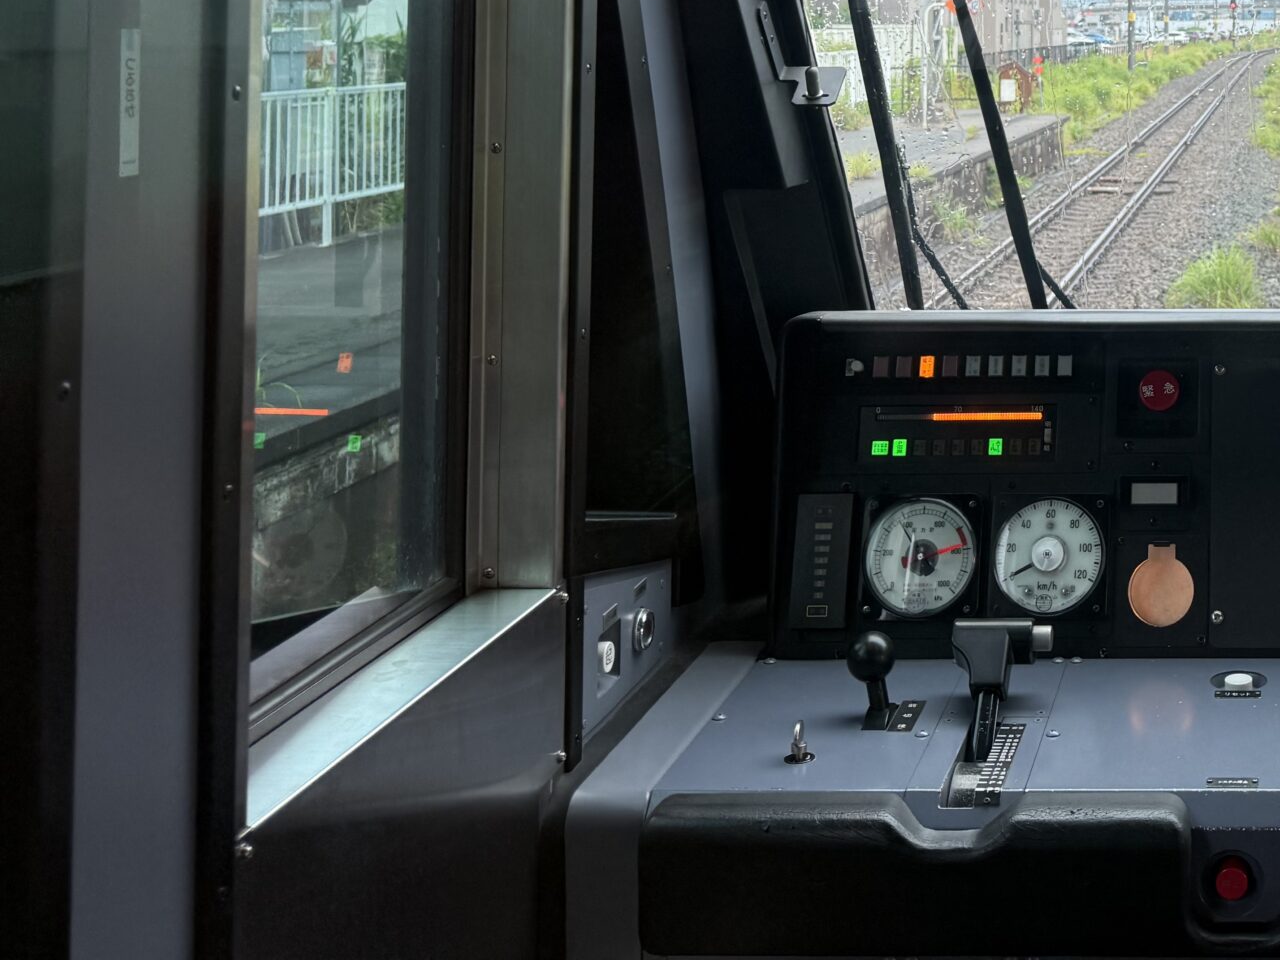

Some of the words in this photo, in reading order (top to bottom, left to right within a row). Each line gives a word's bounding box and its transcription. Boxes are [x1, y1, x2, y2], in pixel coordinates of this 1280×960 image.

[1142, 382, 1175, 398] 緊急
[1045, 508, 1057, 519] 60
[1021, 519, 1032, 529] 40
[1069, 519, 1080, 529] 80
[1006, 543, 1017, 553] 20
[1079, 543, 1093, 553] 100
[1073, 570, 1088, 580] 120
[1037, 581, 1058, 592] km/h
